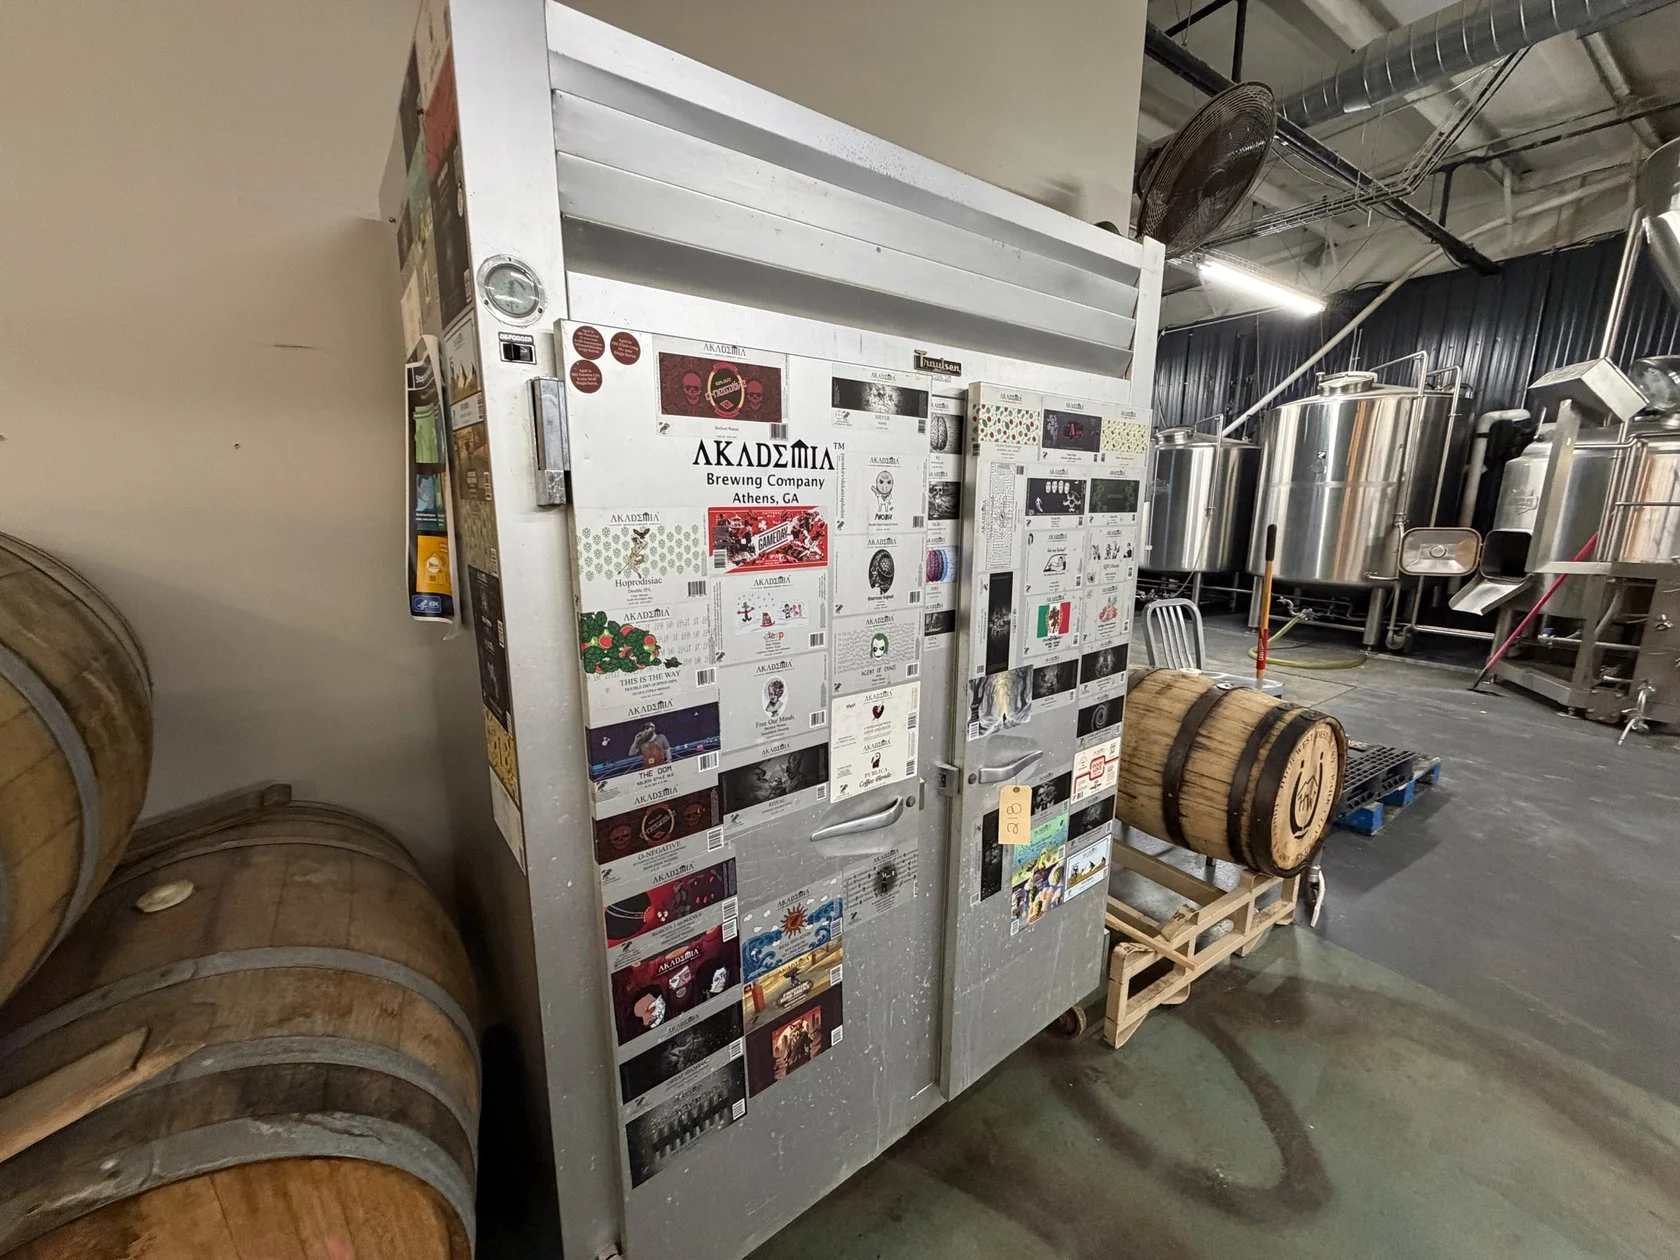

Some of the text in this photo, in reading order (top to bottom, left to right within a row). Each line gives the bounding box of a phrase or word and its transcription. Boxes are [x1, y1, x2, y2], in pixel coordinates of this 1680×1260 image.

[914, 349, 961, 372] Traulsen
[706, 472, 826, 490] Brewing Company
[732, 492, 800, 505] Athens, GA
[758, 526, 789, 551] GAMEDAY
[615, 577, 663, 589] Hoprodisiac
[619, 669, 681, 687] THIS IS THE WAY
[767, 718, 779, 726] Our
[779, 714, 795, 724] Minds
[638, 765, 673, 779] THE DOM
[1006, 802, 1023, 835] 218
[637, 840, 682, 861] O-NEGATIVE
